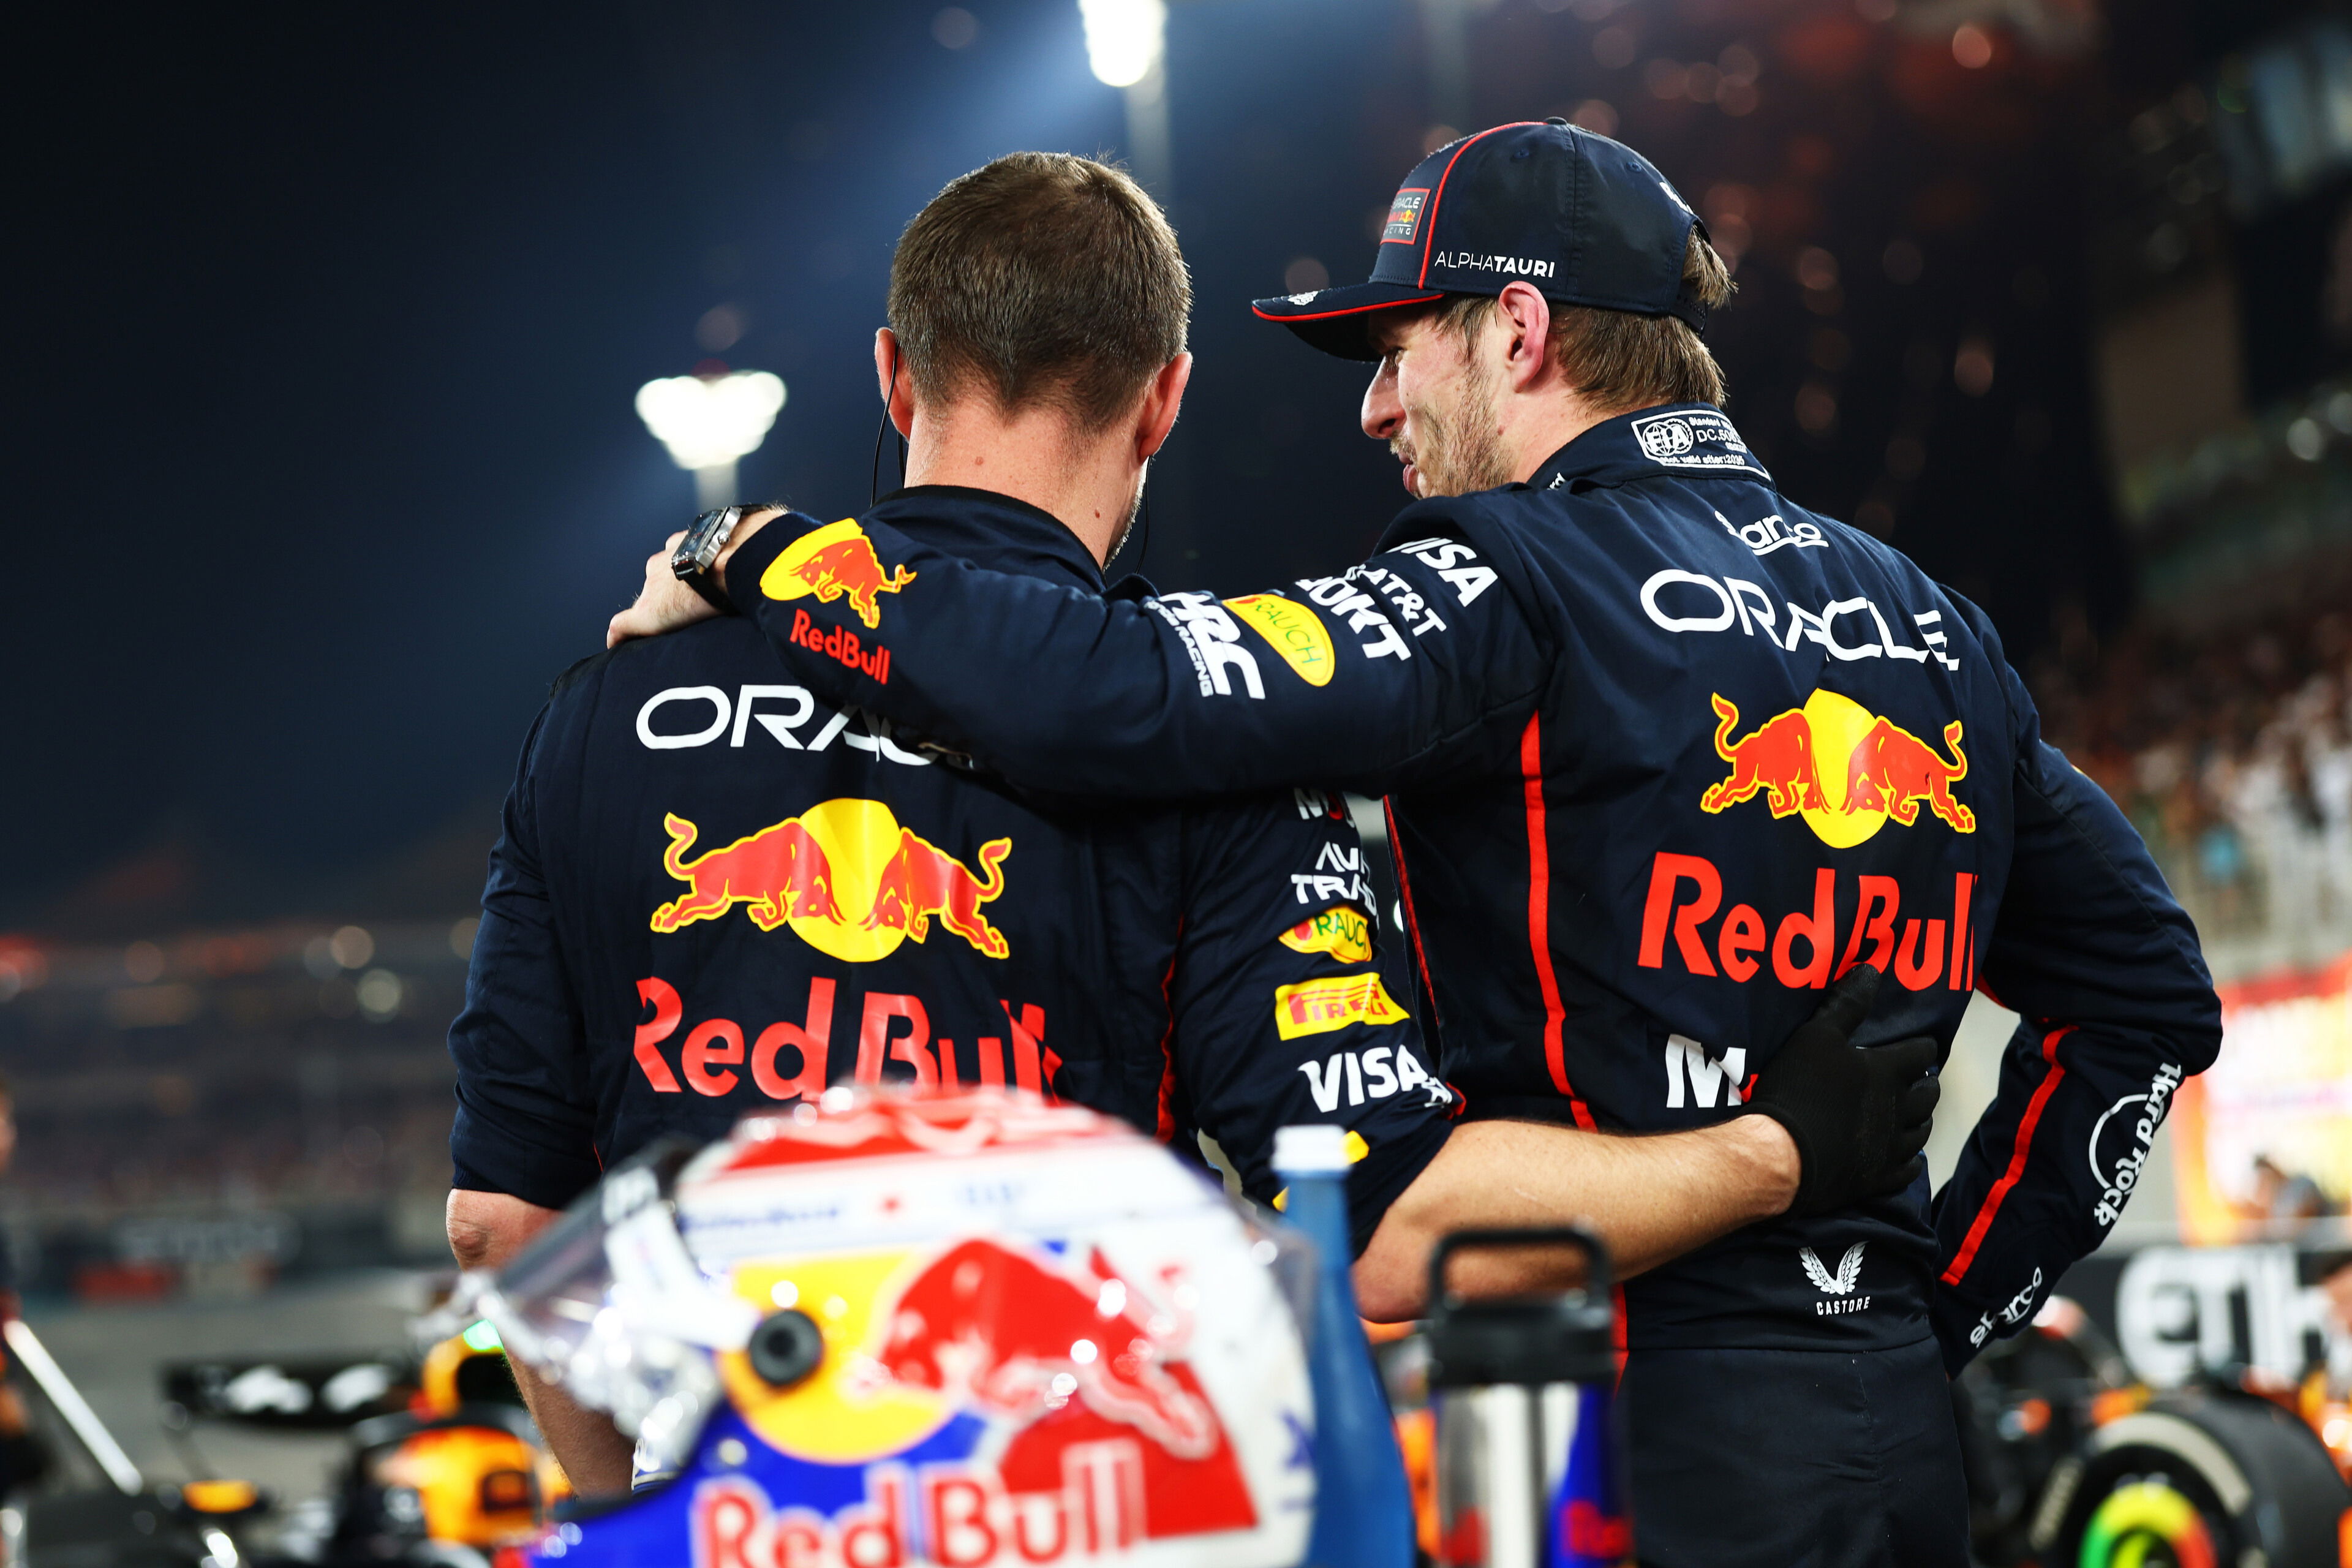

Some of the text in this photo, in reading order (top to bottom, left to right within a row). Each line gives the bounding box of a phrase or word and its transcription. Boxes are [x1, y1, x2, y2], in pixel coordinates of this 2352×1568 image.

[1434, 251, 1555, 278] ALPHATAURI
[1646, 427, 1690, 453] FIA
[1256, 602, 1322, 664] RAUCH
[1640, 569, 1960, 671] ORACLE
[1175, 626, 1214, 697] RACING
[636, 684, 975, 770] ORAC
[1314, 911, 1370, 947] RAUC
[1297, 1044, 1429, 1113] VISA
[2094, 1062, 2182, 1226] Hard Rock
[1816, 1295, 1871, 1316] CASTORE
